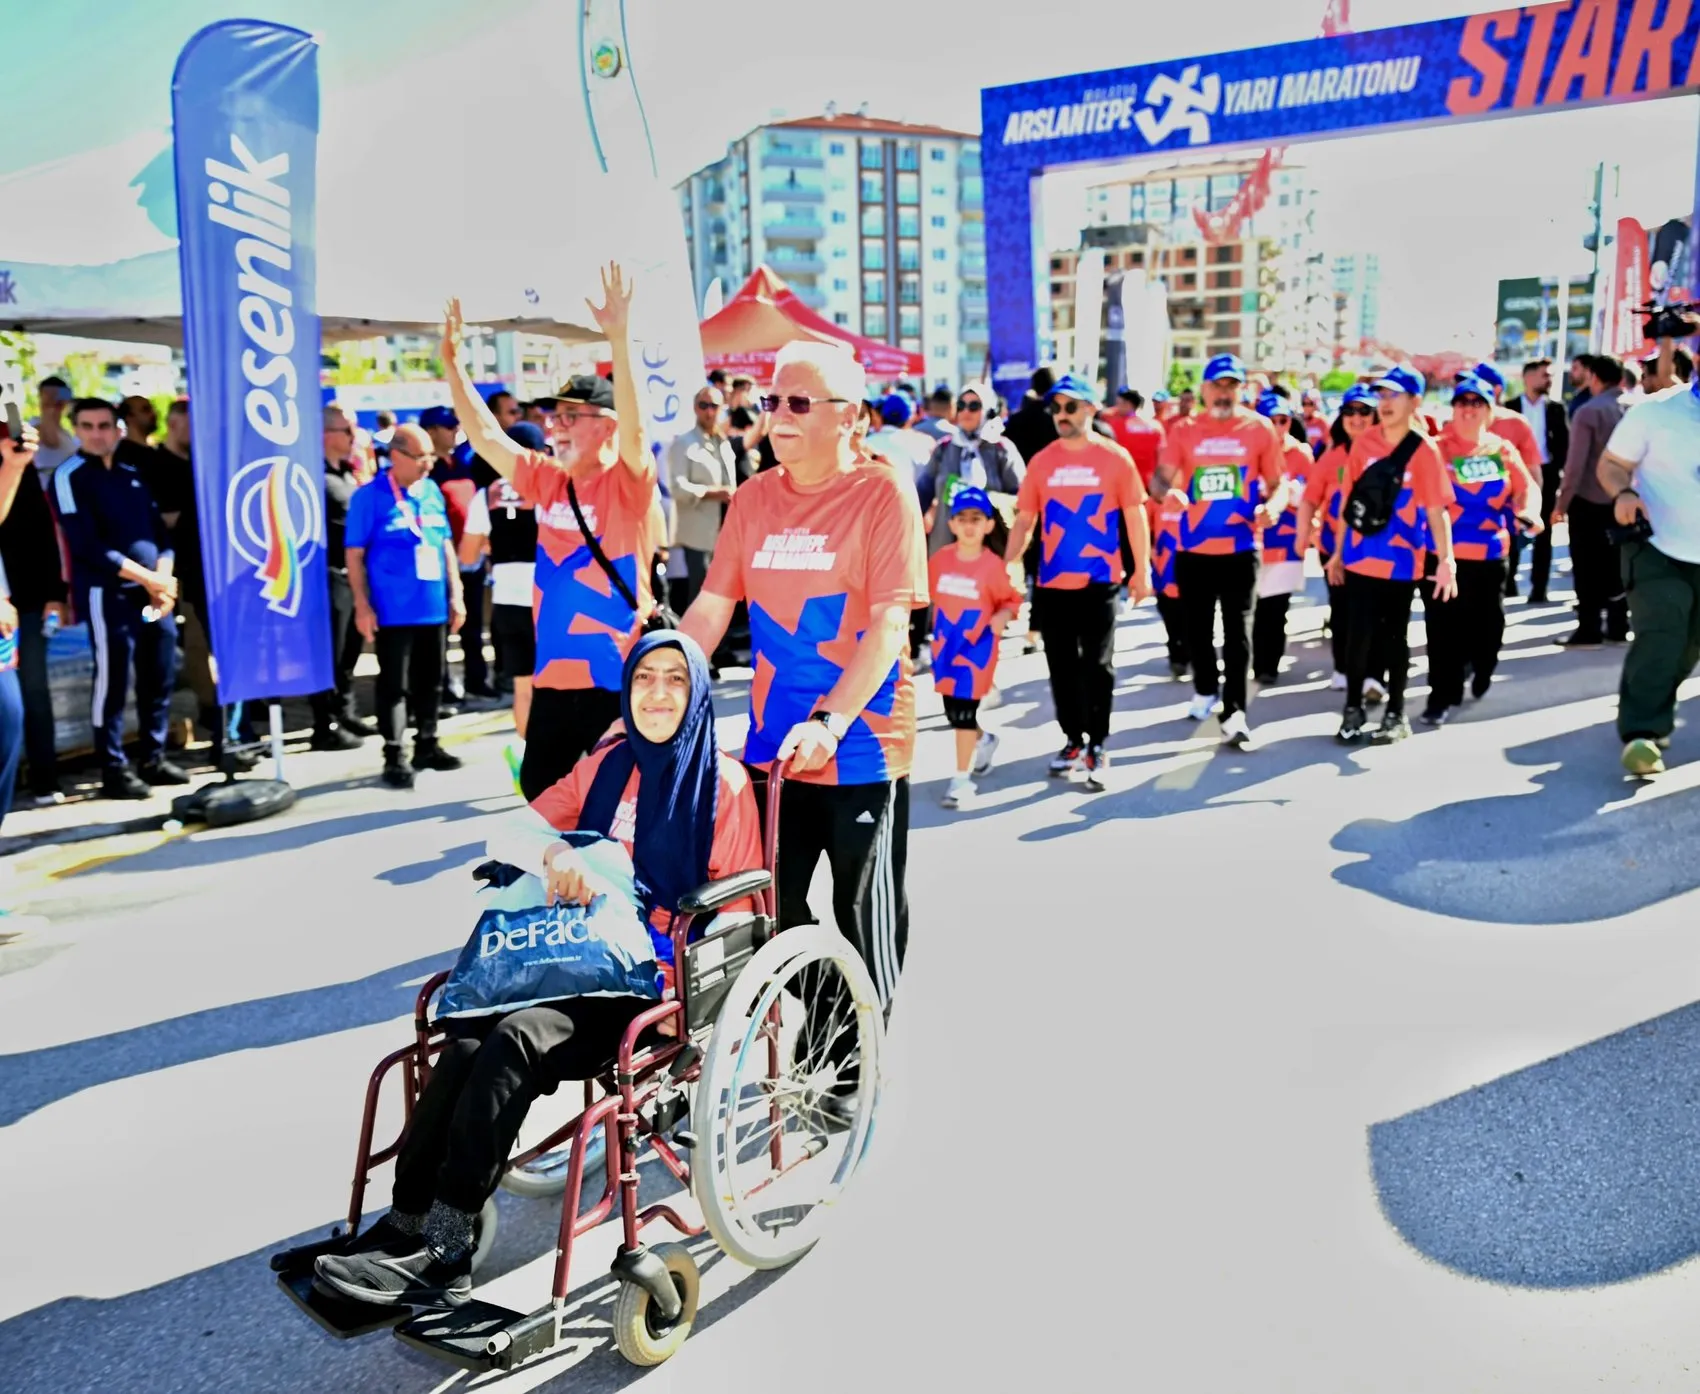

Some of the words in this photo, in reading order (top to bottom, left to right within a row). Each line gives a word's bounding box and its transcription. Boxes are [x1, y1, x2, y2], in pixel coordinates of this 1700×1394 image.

[1223, 76, 1278, 116] YARI
[1277, 55, 1421, 109] MARATONU
[1445, 0, 1700, 116] STAR
[1002, 97, 1134, 146] ARSLANTEPE
[205, 133, 300, 447] esenlik
[480, 915, 601, 959] DeFact
